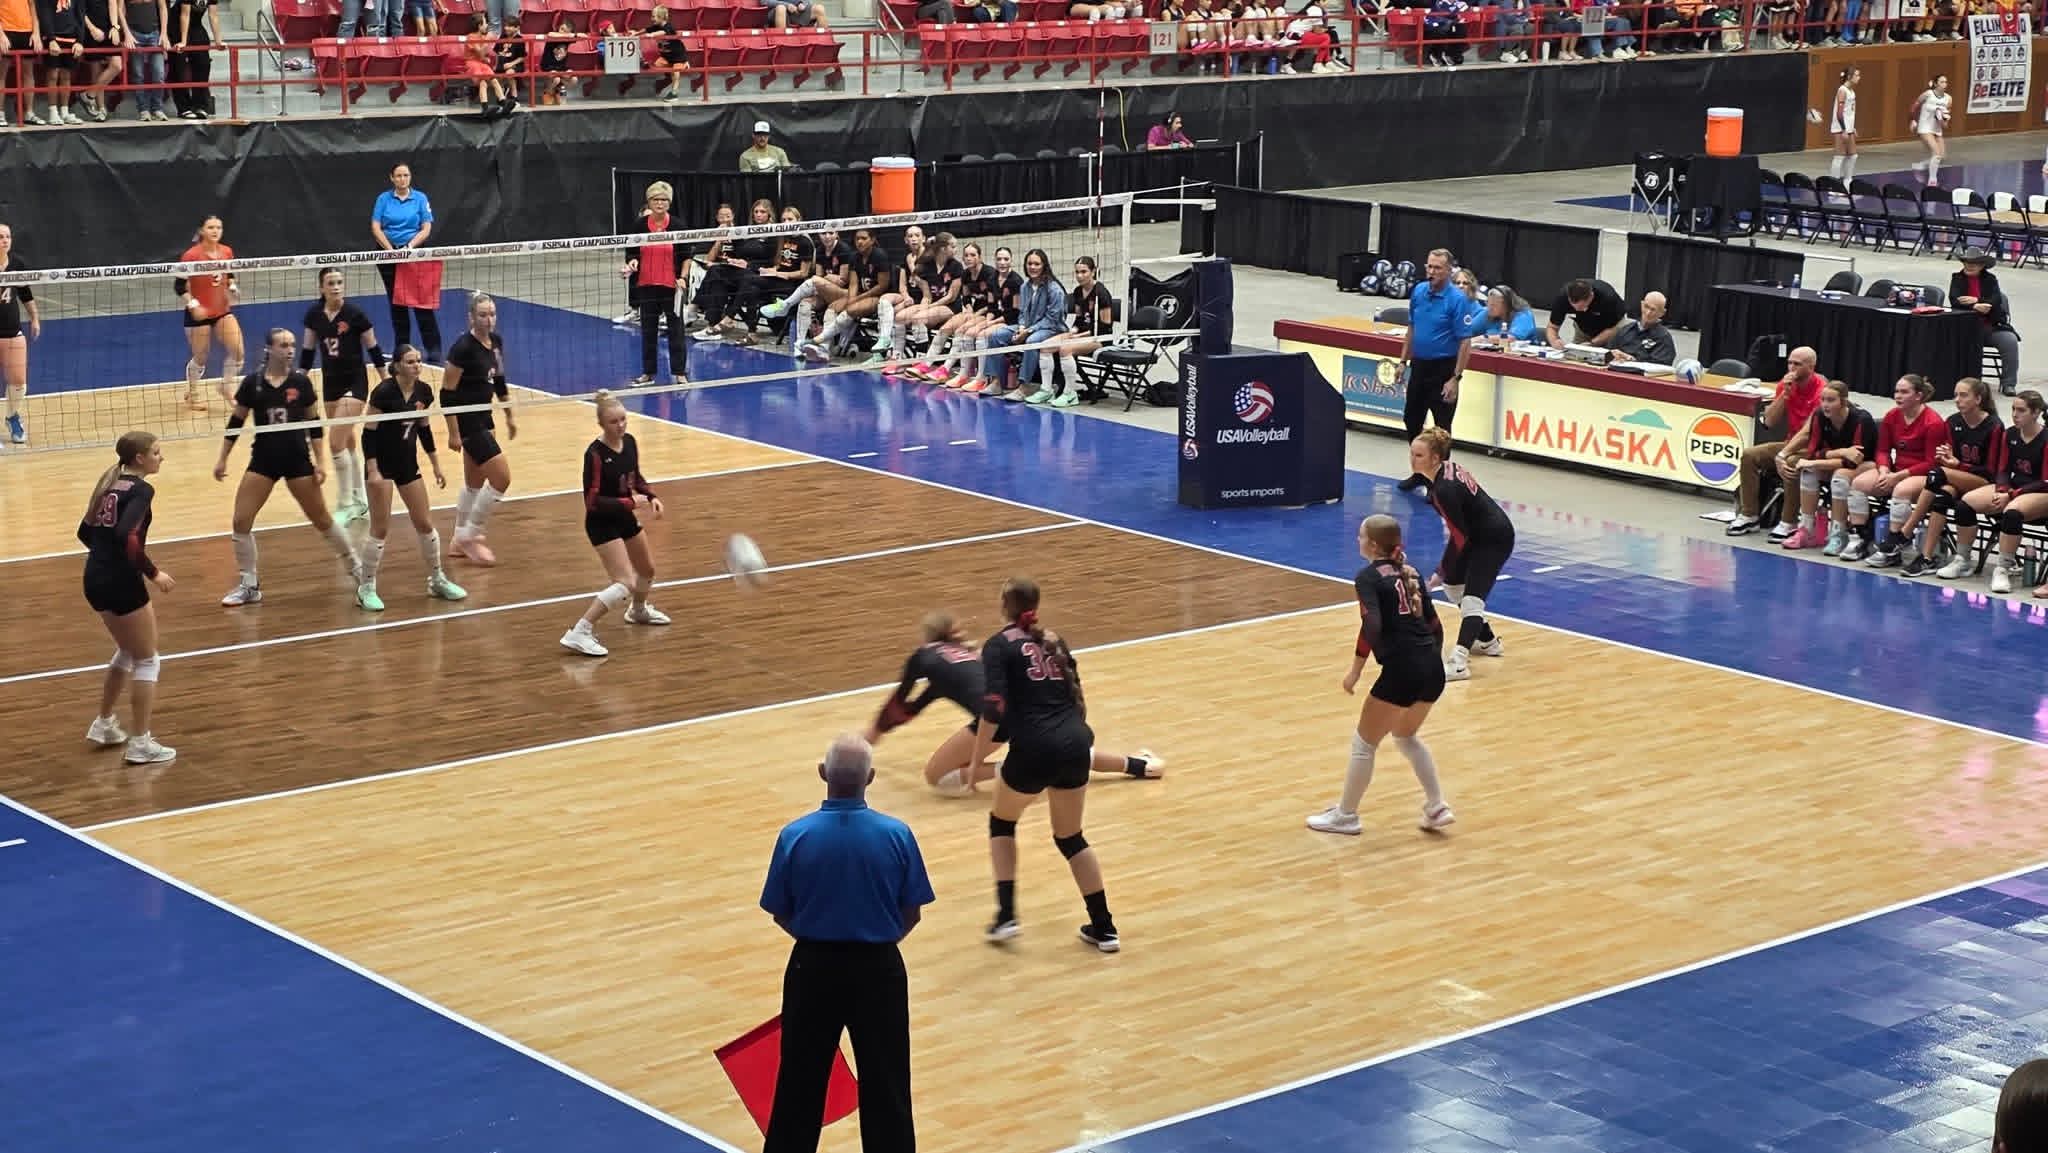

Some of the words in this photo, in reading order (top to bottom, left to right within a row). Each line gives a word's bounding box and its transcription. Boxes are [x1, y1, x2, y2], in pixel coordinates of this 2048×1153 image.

[1973, 18, 2027, 36] ELLIND
[1153, 31, 1172, 47] 121
[608, 41, 636, 58] 119
[676, 229, 730, 240] CHAMPIONSHIP
[748, 225, 774, 234] KSHSAA
[775, 221, 826, 233] CHAMPIONSHIP
[464, 244, 523, 255] CHAMPIONSHIP
[542, 240, 571, 249] KSHSAA
[573, 237, 629, 248] CHAMPIONSHIP
[230, 258, 295, 269] CHAMPIONSHIP
[315, 254, 347, 265] KSHSAA
[350, 250, 412, 262] CHAMPIONSHIP
[65, 268, 101, 279] KSHSAA
[104, 265, 173, 277] CHAMPIONSHIP
[324, 337, 340, 357] 12
[1184, 364, 1198, 438] USAVolleyball
[267, 407, 288, 425] 13
[402, 422, 414, 440] 7
[1216, 427, 1291, 445] USAVolleyball
[1505, 409, 1677, 471] MAHASKA
[1690, 438, 1740, 460] PEPSI
[1221, 488, 1249, 499] sports
[1250, 487, 1285, 497] imports
